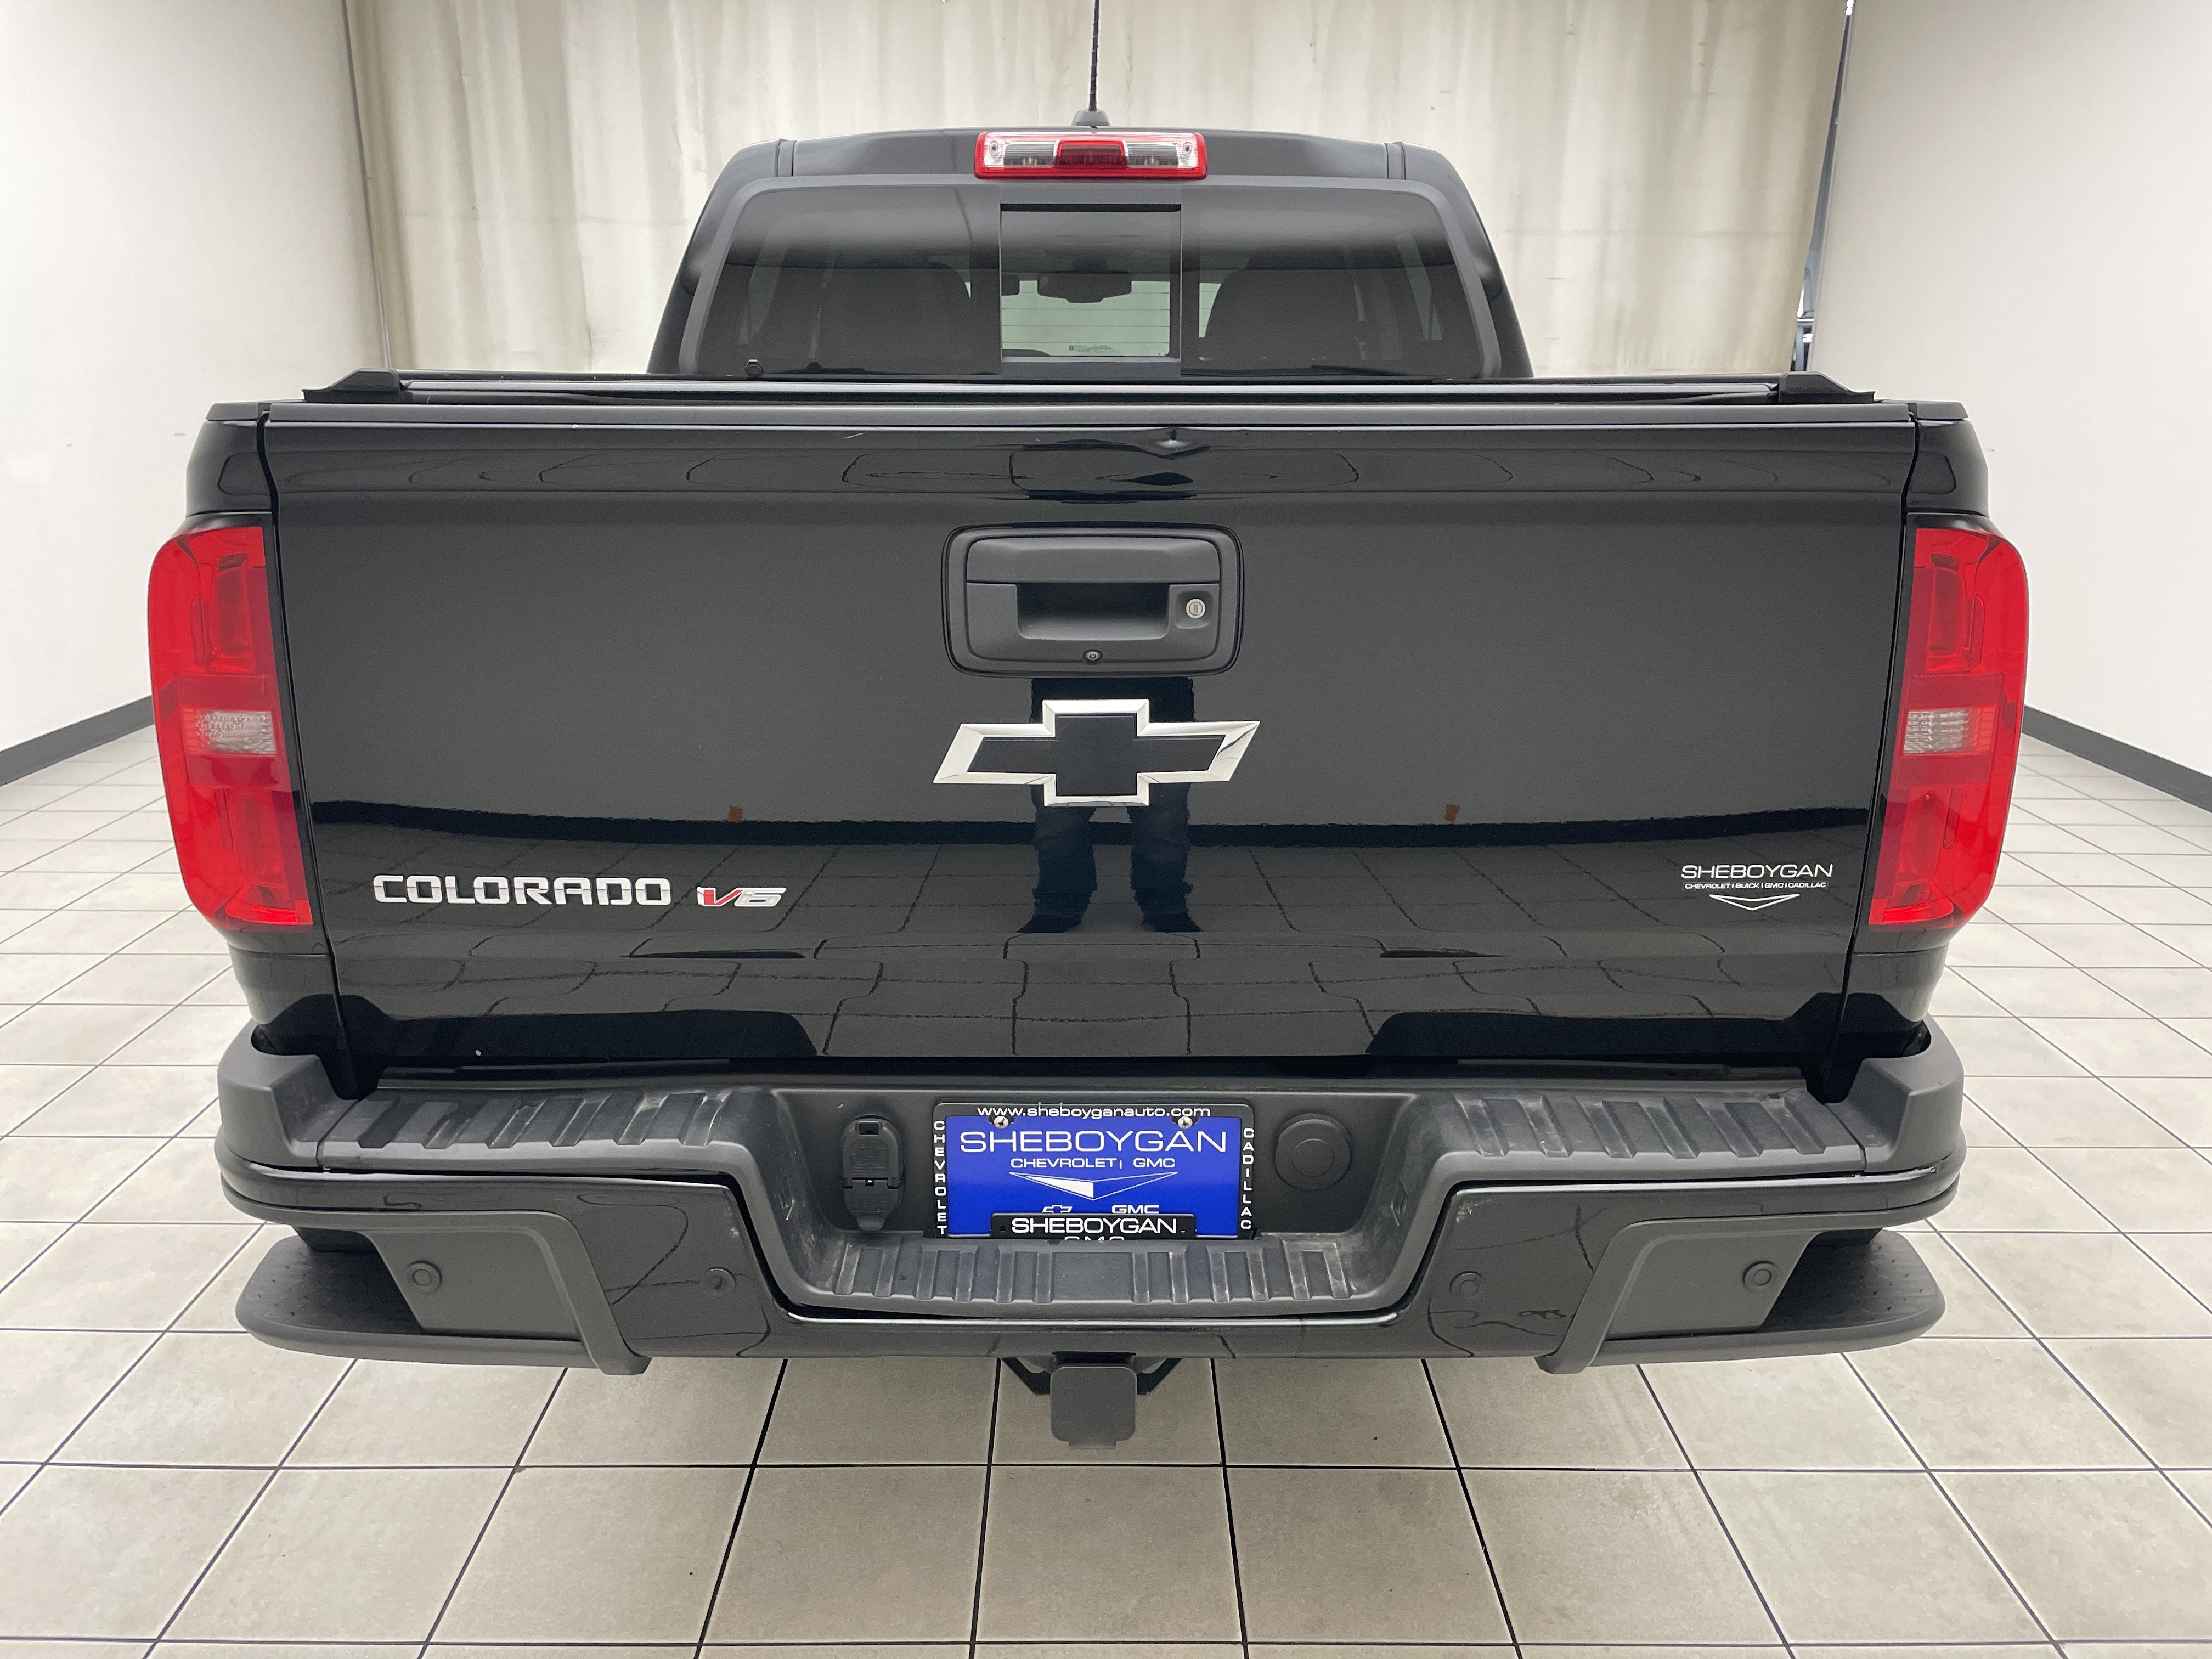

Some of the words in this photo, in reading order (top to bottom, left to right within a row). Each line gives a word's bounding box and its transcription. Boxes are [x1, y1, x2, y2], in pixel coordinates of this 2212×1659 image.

[1681, 864, 1833, 879] SHEBOYGAN
[373, 874, 672, 905] COLORADO
[697, 887, 787, 907] V6
[977, 1105, 1211, 1119] www.sheboyganauto.com
[960, 1131, 1226, 1153] SHEBOYGAN
[1011, 1158, 1117, 1168] CHEVROLET
[1133, 1158, 1175, 1168] GMC
[934, 1120, 947, 1235] CHEVROLET
[1240, 1128, 1254, 1229] CADILLAC
[1111, 1205, 1160, 1213] GMC
[1012, 1217, 1177, 1234] SHEBOYGAN
